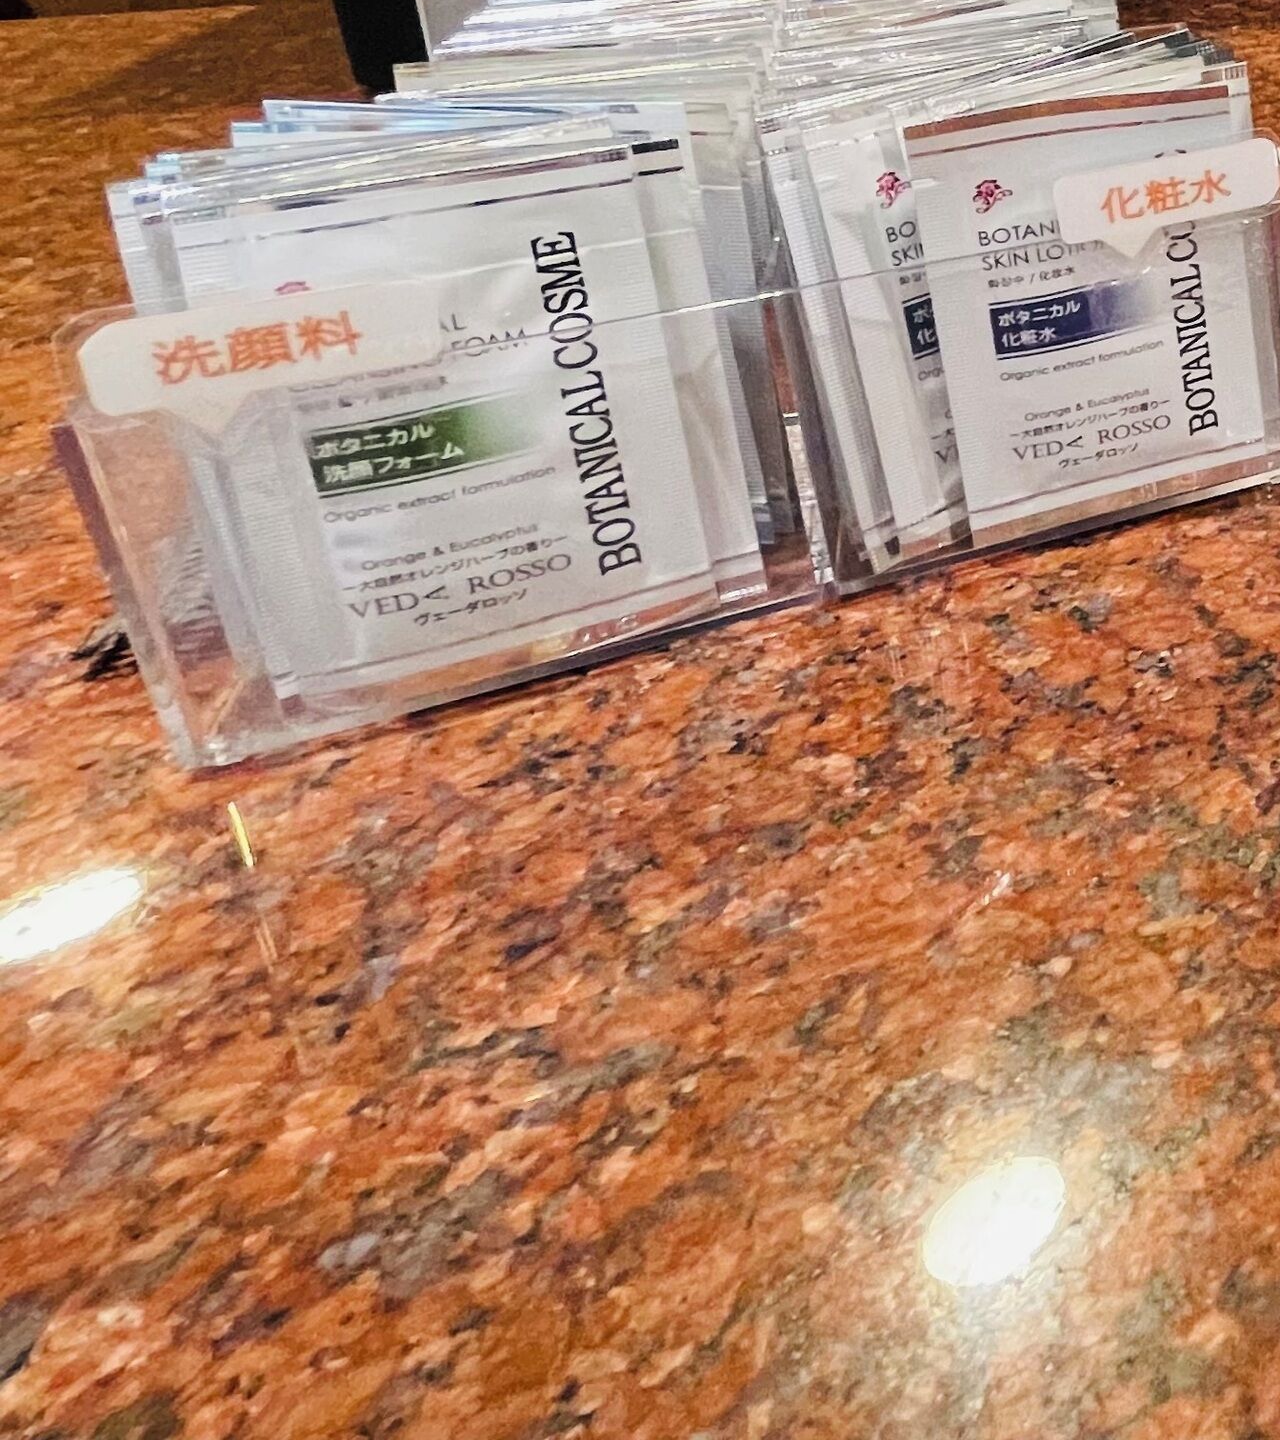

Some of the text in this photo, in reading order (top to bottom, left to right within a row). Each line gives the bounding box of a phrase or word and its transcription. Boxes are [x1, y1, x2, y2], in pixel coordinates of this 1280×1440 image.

[1100, 169, 1232, 224] 化粧水
[982, 250, 1030, 271] SKIN
[998, 300, 1080, 327] ボタニカル
[153, 310, 362, 385] 洗顔料
[1001, 327, 1057, 348] 化粧水
[1161, 263, 1219, 436] BOTANICAL
[1000, 339, 1163, 381] Organic extract formulation
[530, 231, 642, 575] BOTANICAL COSME
[1024, 388, 1150, 422] Orange & Eucalyptus
[314, 422, 435, 459] ボタニカル
[1098, 414, 1171, 445] ROSSO
[323, 441, 465, 484] 洗顔フォーム
[324, 466, 556, 523] Organic extract formulation
[361, 523, 539, 571] Orange & Eucalyptus
[467, 553, 572, 594] ROSSO
